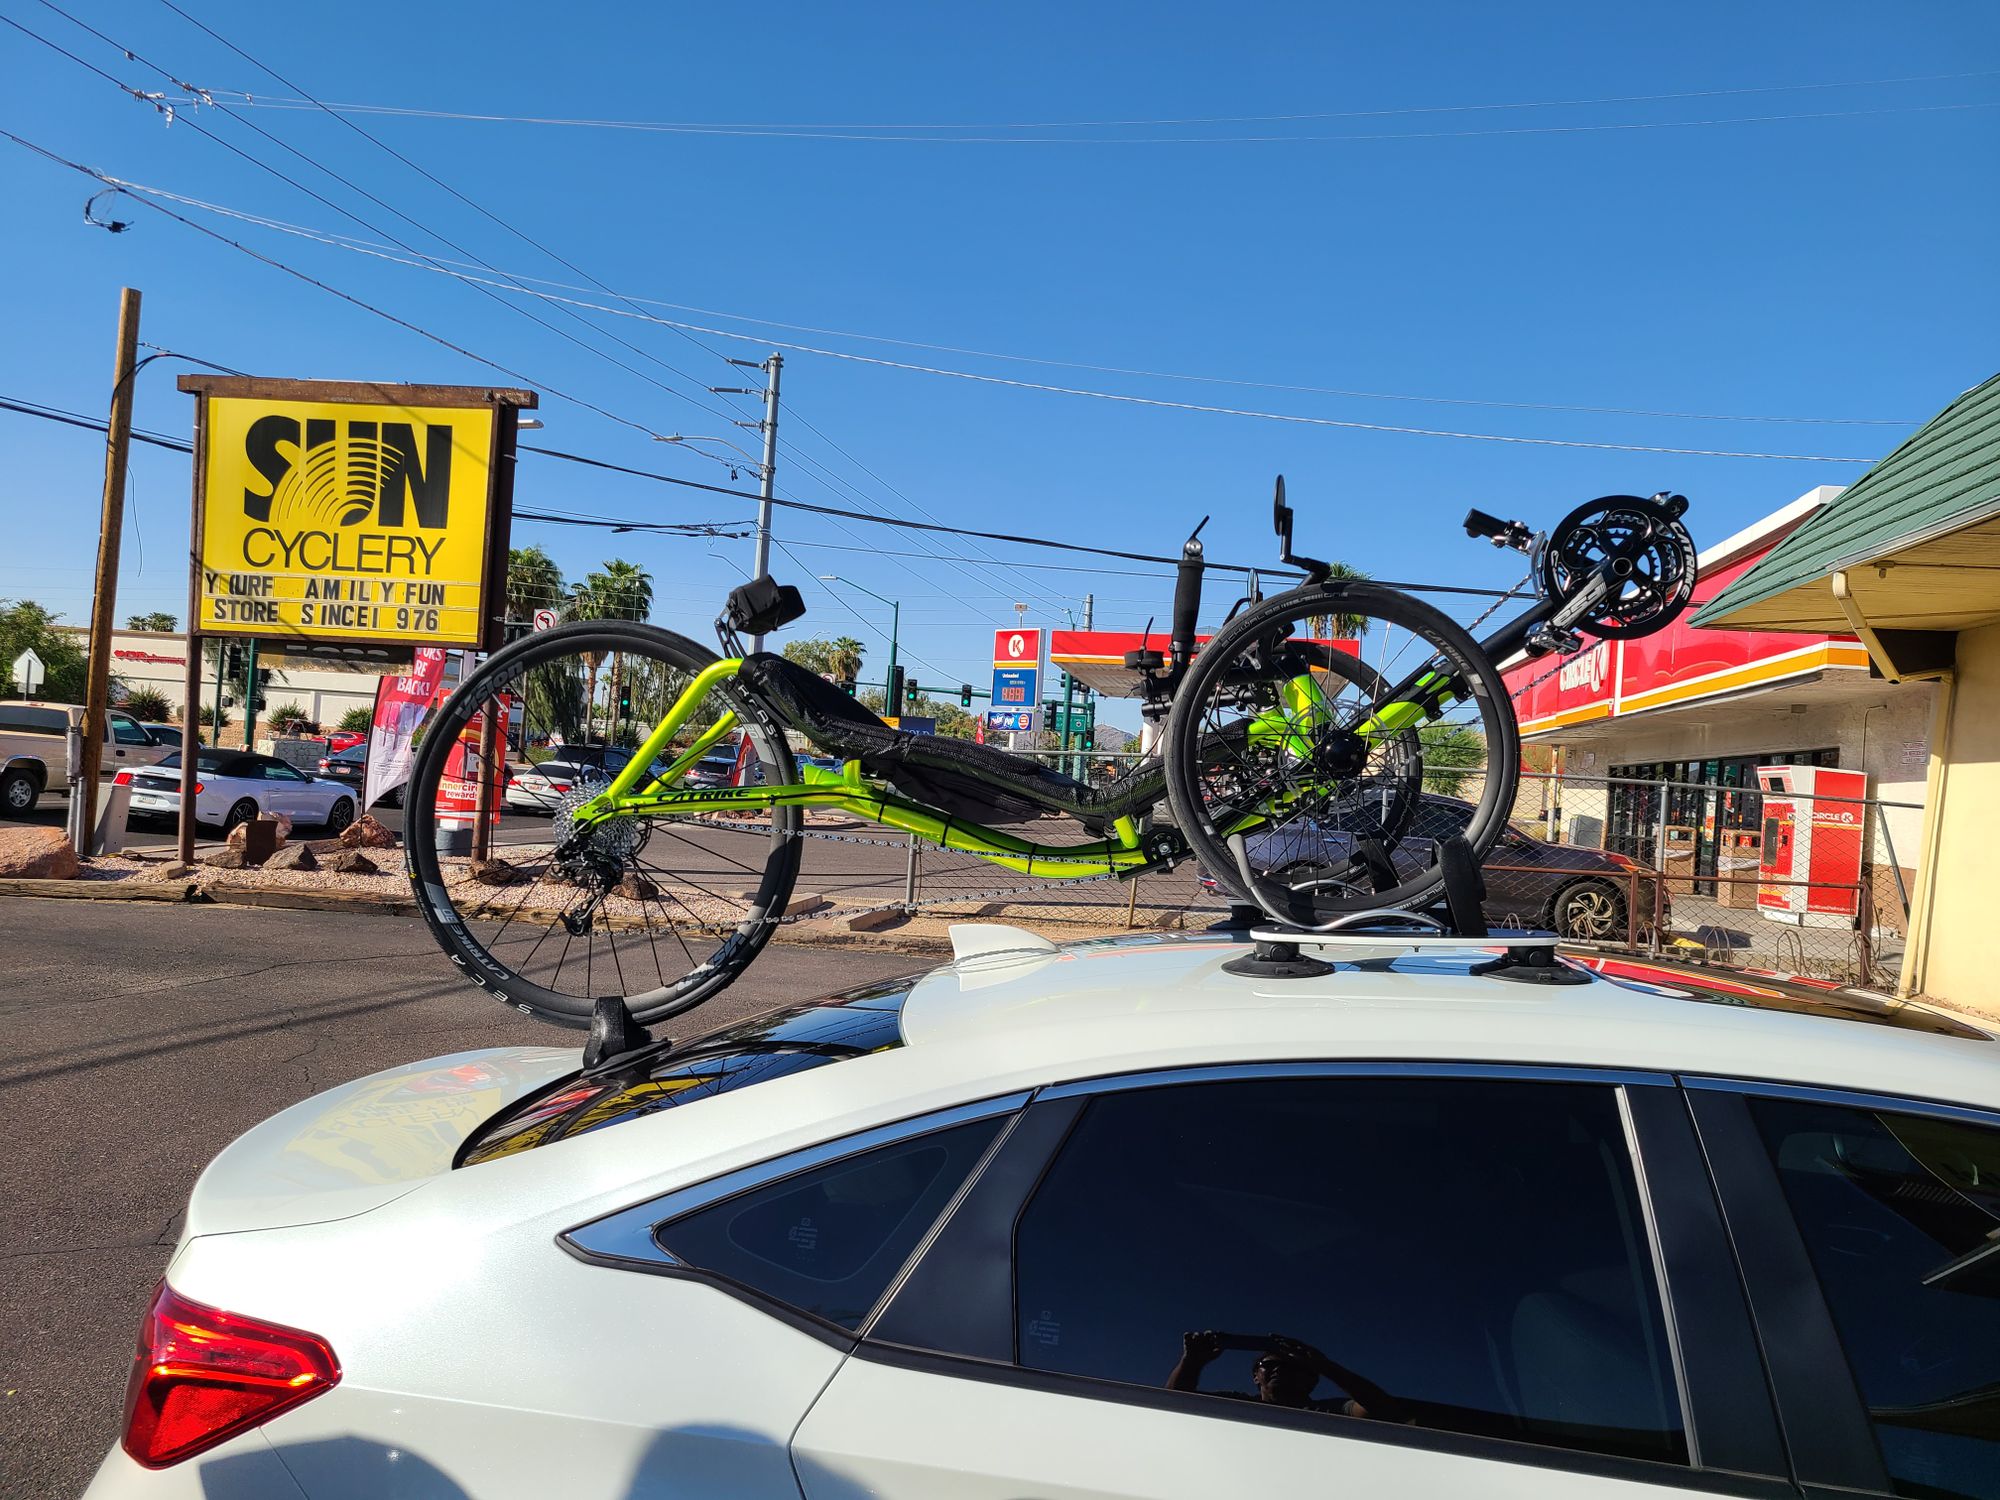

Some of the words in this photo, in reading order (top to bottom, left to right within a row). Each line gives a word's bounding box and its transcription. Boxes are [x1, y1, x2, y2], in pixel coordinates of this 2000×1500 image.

[244, 415, 453, 530] SUN
[243, 527, 446, 575] CYCLERY
[1670, 521, 1695, 600] CATRIKE
[405, 582, 445, 605] FUN
[214, 599, 278, 623] STORE
[397, 677, 431, 696] BACK!
[657, 788, 752, 802] CATRIKE
[1812, 812, 1840, 821] CIRCLE
[450, 923, 510, 981] CATRIKE
